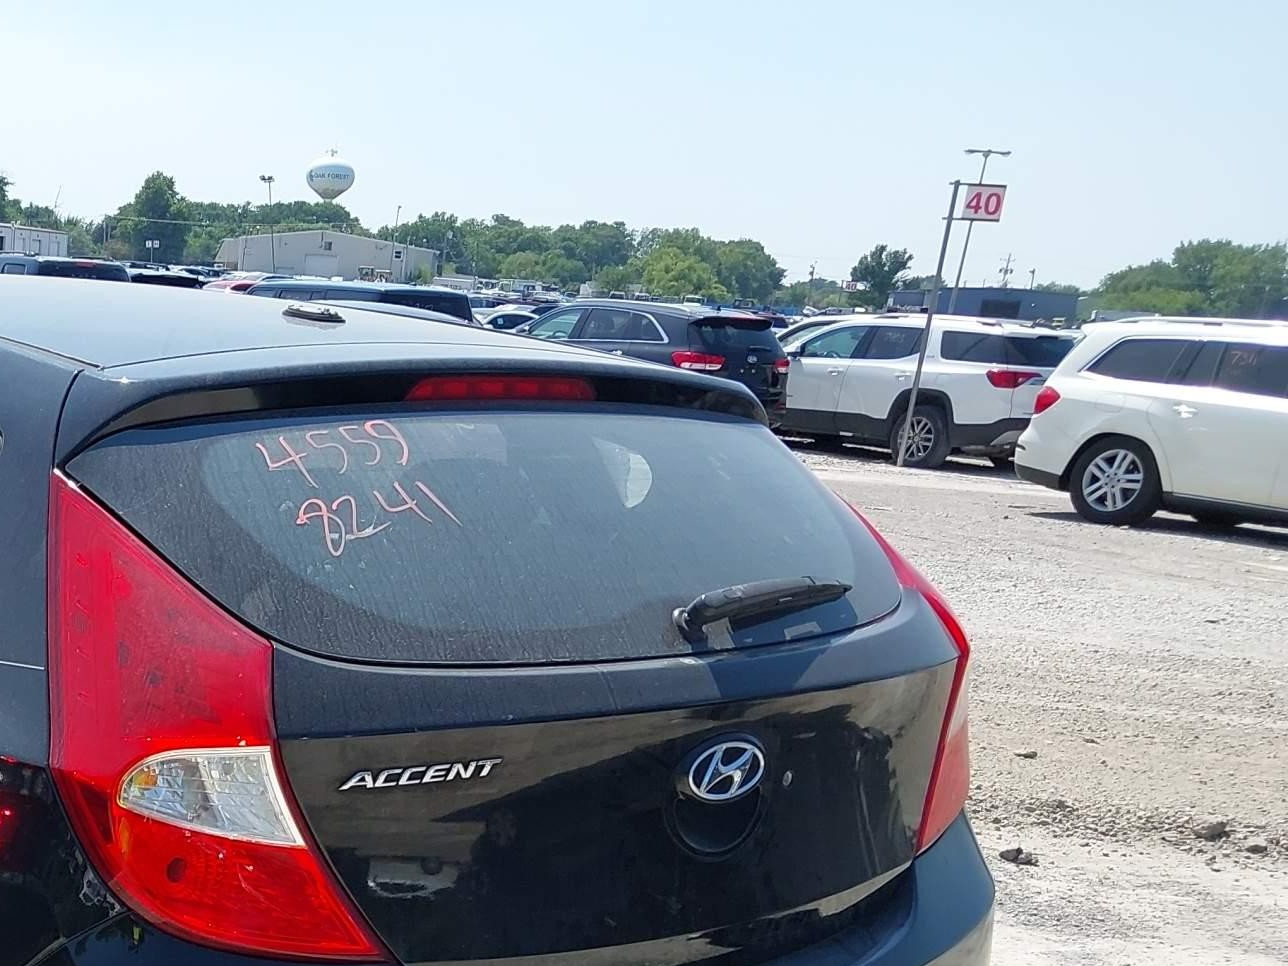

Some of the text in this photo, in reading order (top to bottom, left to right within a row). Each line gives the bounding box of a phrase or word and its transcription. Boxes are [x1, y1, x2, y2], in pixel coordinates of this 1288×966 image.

[327, 172, 350, 180] FOREST
[965, 191, 1002, 216] 40
[255, 419, 409, 489] 4559
[295, 480, 463, 558] 8241
[338, 758, 504, 791] ACCENT
